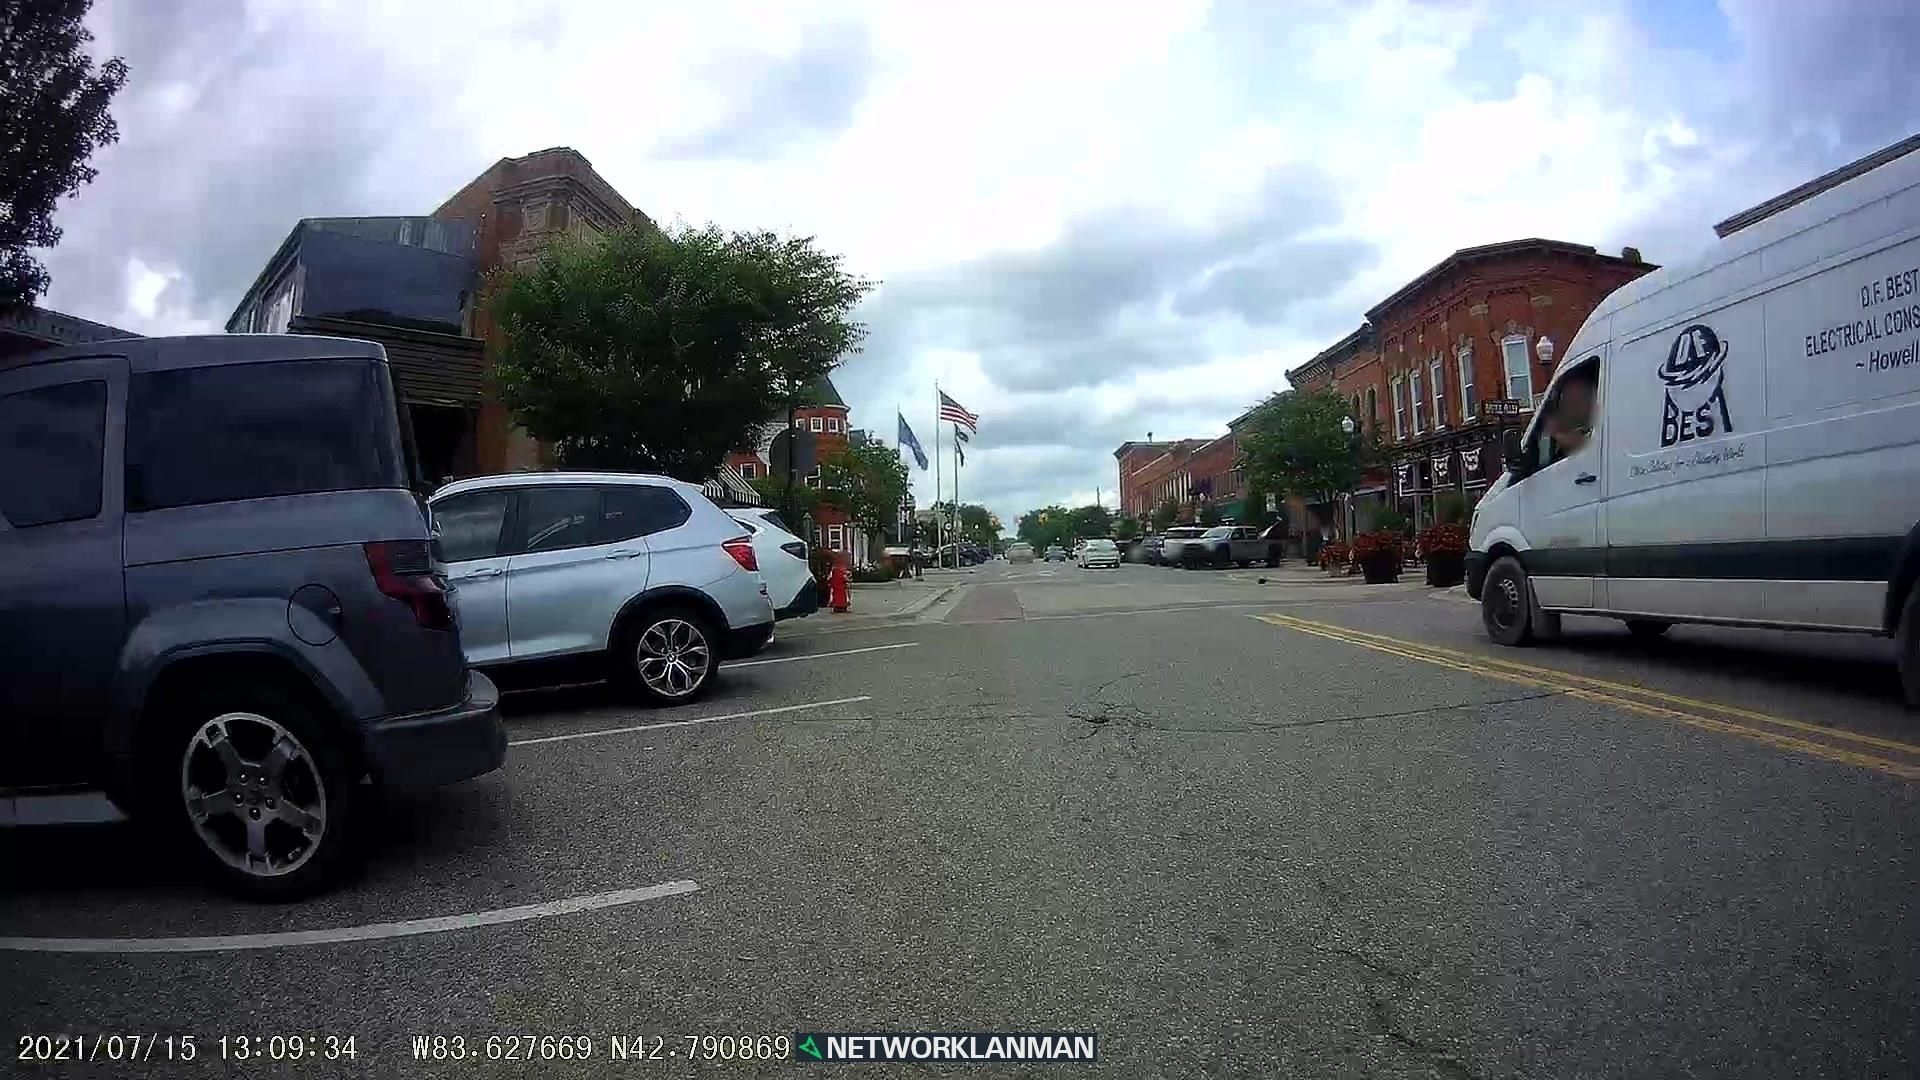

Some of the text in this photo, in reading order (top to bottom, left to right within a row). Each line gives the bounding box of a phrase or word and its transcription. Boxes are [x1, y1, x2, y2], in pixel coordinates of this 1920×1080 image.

[1861, 268, 1919, 308] D.F. BEST
[1805, 316, 1882, 357] ELECTRICAL
[1660, 365, 1733, 448] BEST
